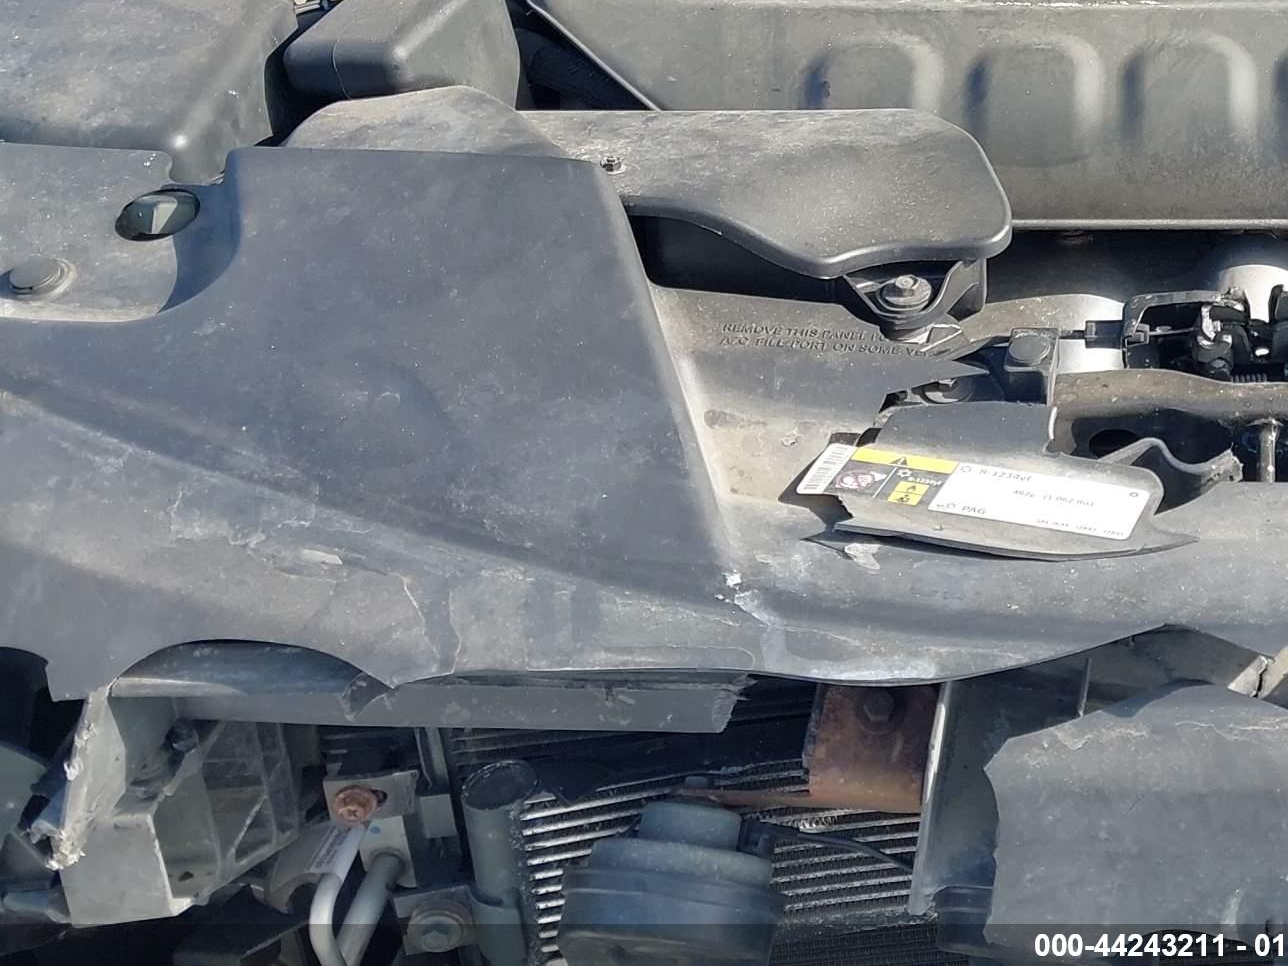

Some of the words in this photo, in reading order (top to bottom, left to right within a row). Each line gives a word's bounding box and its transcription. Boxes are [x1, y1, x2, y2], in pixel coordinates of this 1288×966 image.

[722, 322, 783, 336] REMOVE
[787, 327, 818, 338] THIS
[822, 330, 865, 341] PANEL
[719, 336, 749, 346] A/C
[833, 342, 855, 352] ON
[859, 344, 900, 355] SOME
[961, 505, 987, 516] PAG
